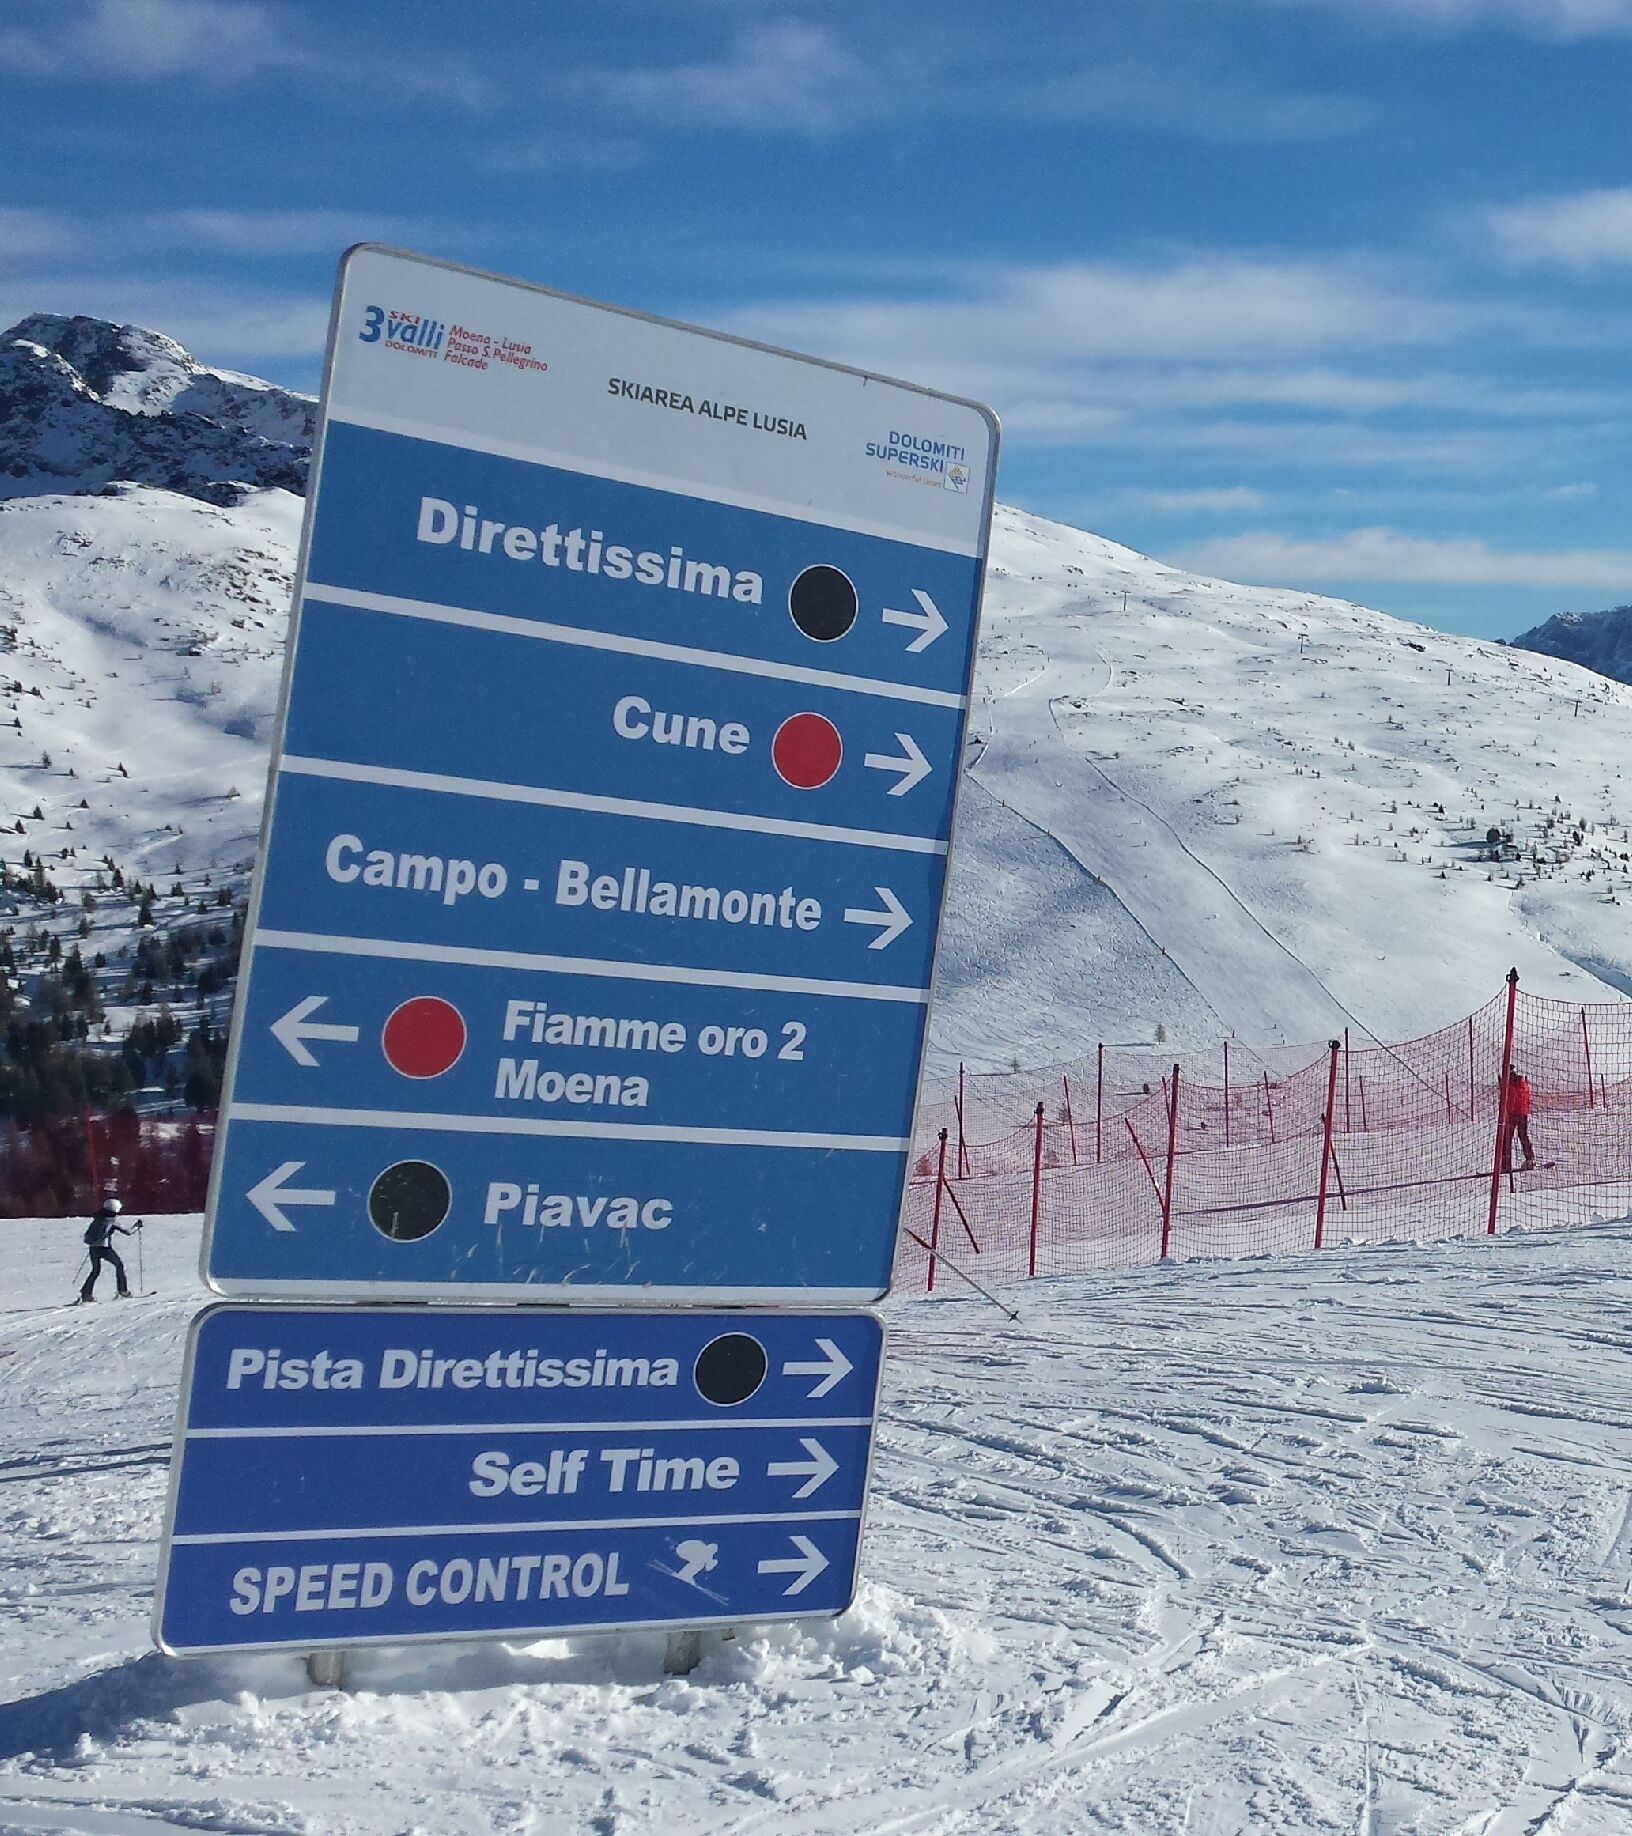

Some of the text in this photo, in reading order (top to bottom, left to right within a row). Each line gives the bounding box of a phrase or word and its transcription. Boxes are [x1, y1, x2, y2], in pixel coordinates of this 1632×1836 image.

[443, 350, 488, 371] Falcade
[448, 338, 478, 355] Passo
[494, 349, 548, 371] Pellegrino
[449, 324, 491, 345] Moena
[501, 337, 532, 355] Lusia
[608, 378, 808, 440] SKIAREA ALPE LUSIA
[865, 443, 944, 473] SUPERSKI
[889, 431, 965, 461] DOLOMITI
[417, 496, 764, 605] Direttissima
[613, 696, 751, 755] Cune
[325, 834, 508, 904] Campo
[555, 860, 822, 932] Bellamonte
[503, 1000, 807, 1061] Fiamme oro 2
[495, 1057, 650, 1107] Moena
[483, 1182, 674, 1230] Piavac
[226, 1349, 679, 1391] Pista Direttissima
[469, 1448, 740, 1497] Self Time
[230, 1553, 630, 1616] SPEED CONTROL
